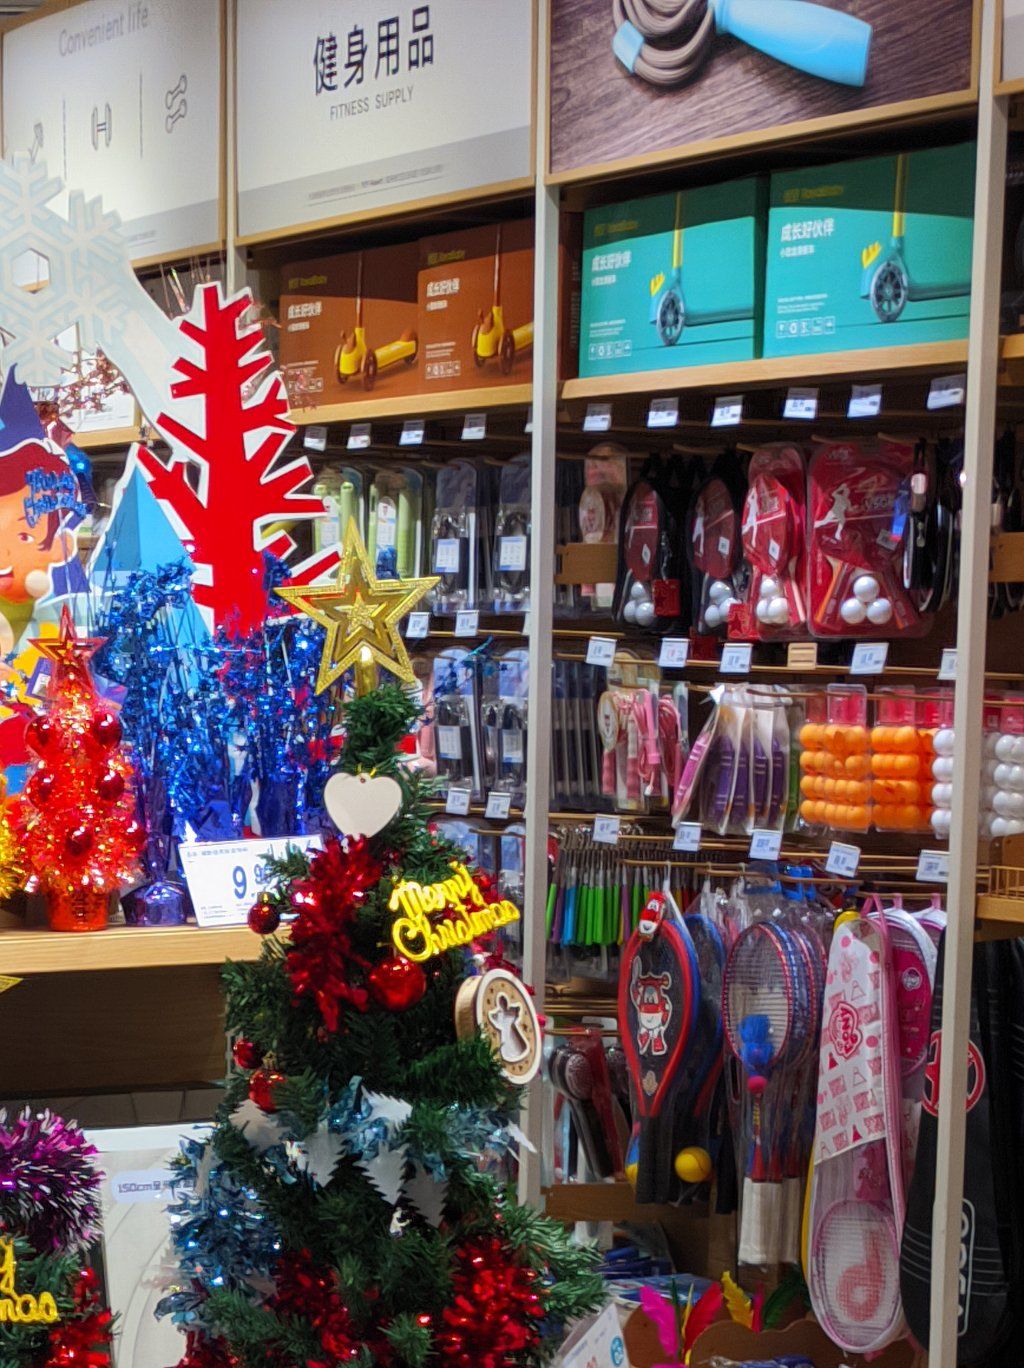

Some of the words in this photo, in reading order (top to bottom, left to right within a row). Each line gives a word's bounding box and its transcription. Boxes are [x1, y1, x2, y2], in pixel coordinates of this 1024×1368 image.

[58, 23, 125, 58] Convenient
[127, 3, 149, 30] life
[312, 4, 435, 96] 健身用品
[329, 98, 370, 121] FITNESS
[374, 86, 415, 110] SUPPLY
